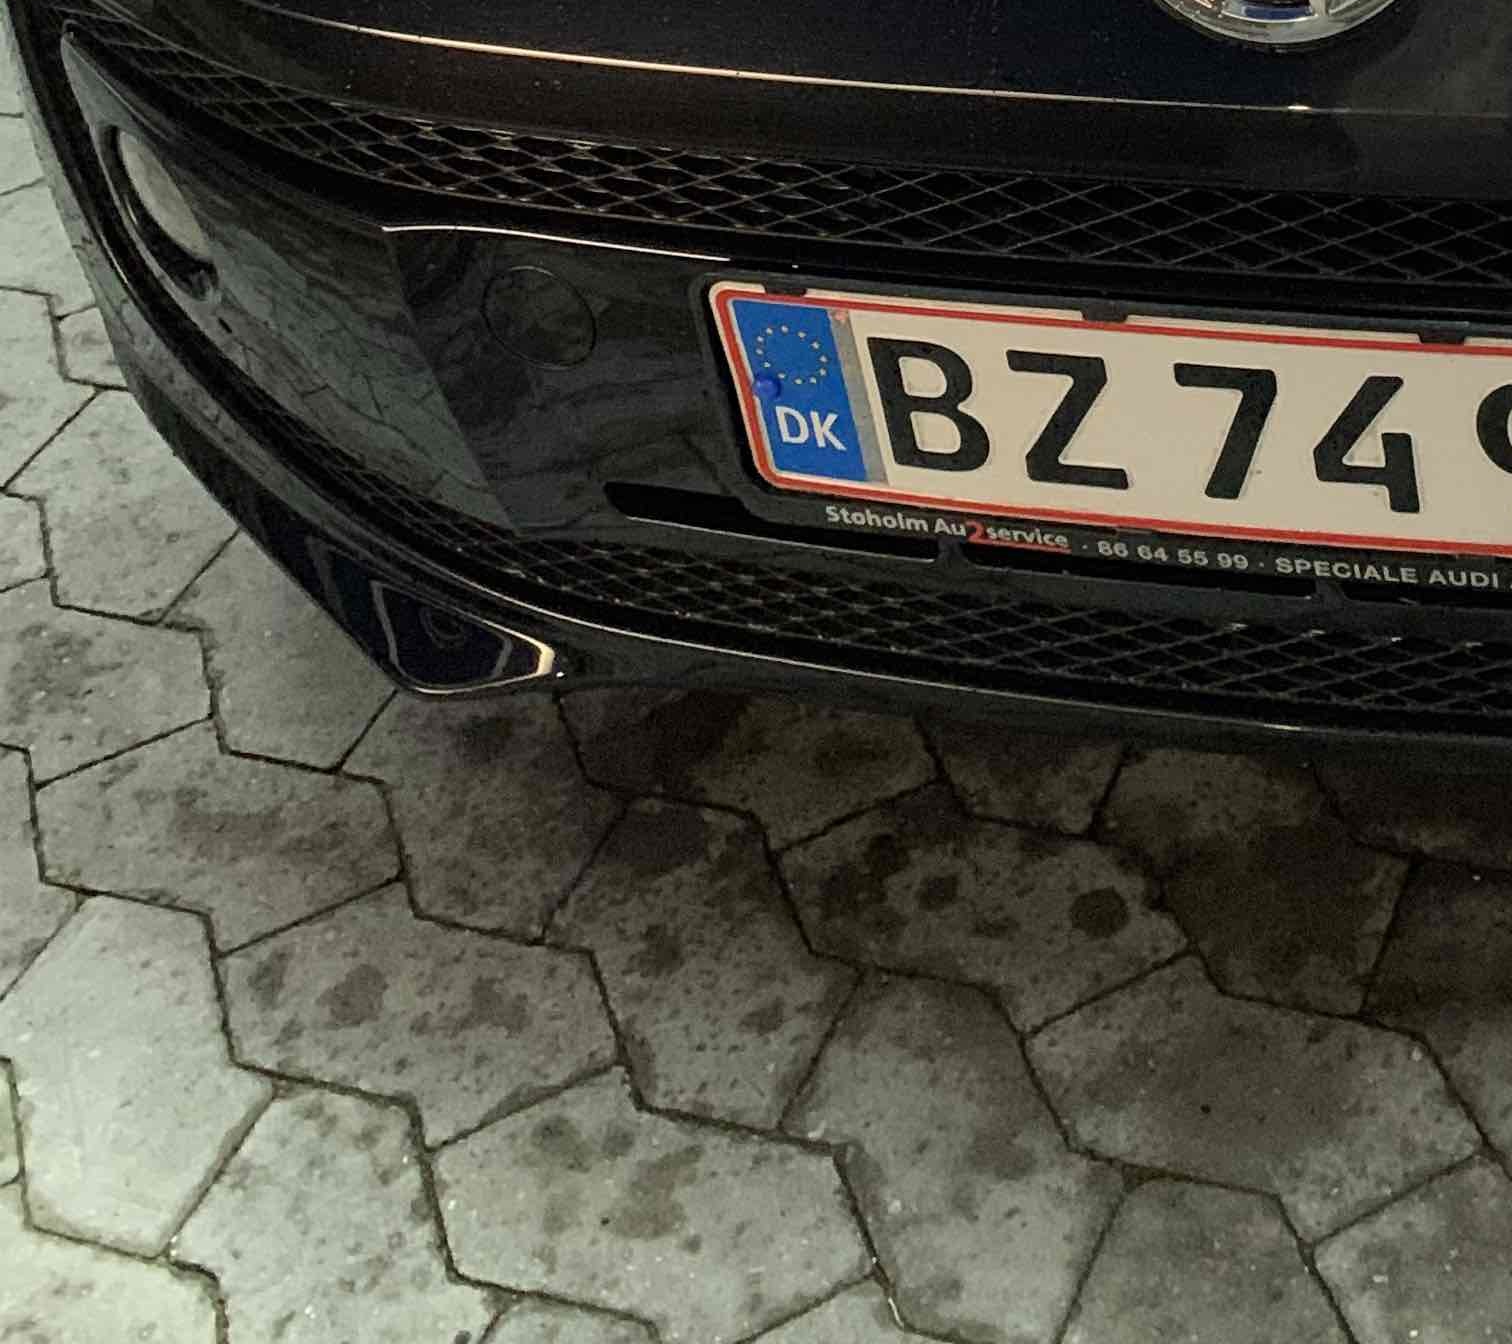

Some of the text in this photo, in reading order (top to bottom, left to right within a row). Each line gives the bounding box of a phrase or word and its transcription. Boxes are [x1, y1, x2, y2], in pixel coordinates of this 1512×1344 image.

[774, 405, 847, 452] DK
[867, 335, 1129, 491] BZ
[1173, 362, 1420, 514] 74
[825, 505, 929, 534] Stoholm
[933, 518, 1071, 551] Au2service
[1137, 544, 1169, 562] 64
[1178, 548, 1209, 566] 55
[1217, 552, 1249, 570] 99
[1275, 557, 1418, 585] SPECIALE
[1428, 570, 1500, 589] AUDI
